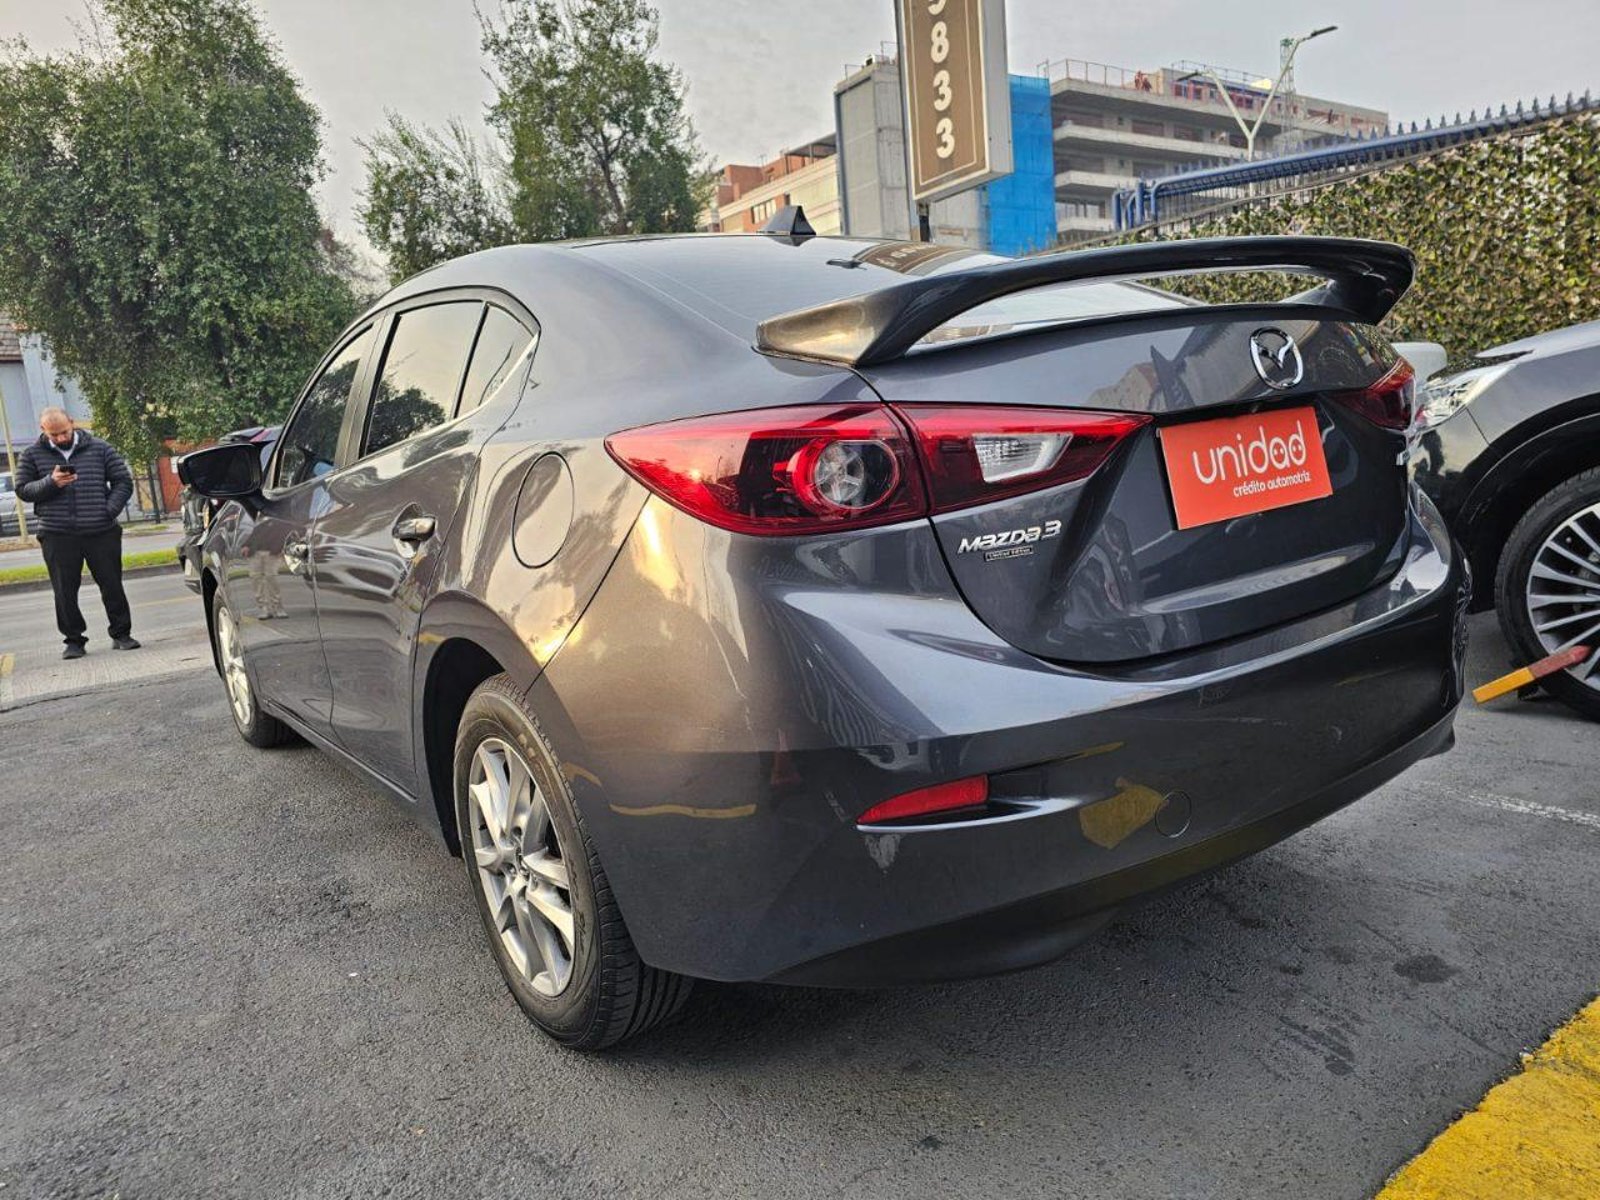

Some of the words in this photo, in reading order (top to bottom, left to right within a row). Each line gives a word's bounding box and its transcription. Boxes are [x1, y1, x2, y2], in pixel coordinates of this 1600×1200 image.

[1192, 420, 1307, 485] unidad
[1233, 480, 1266, 497] crédito
[1267, 470, 1311, 490] automotriz
